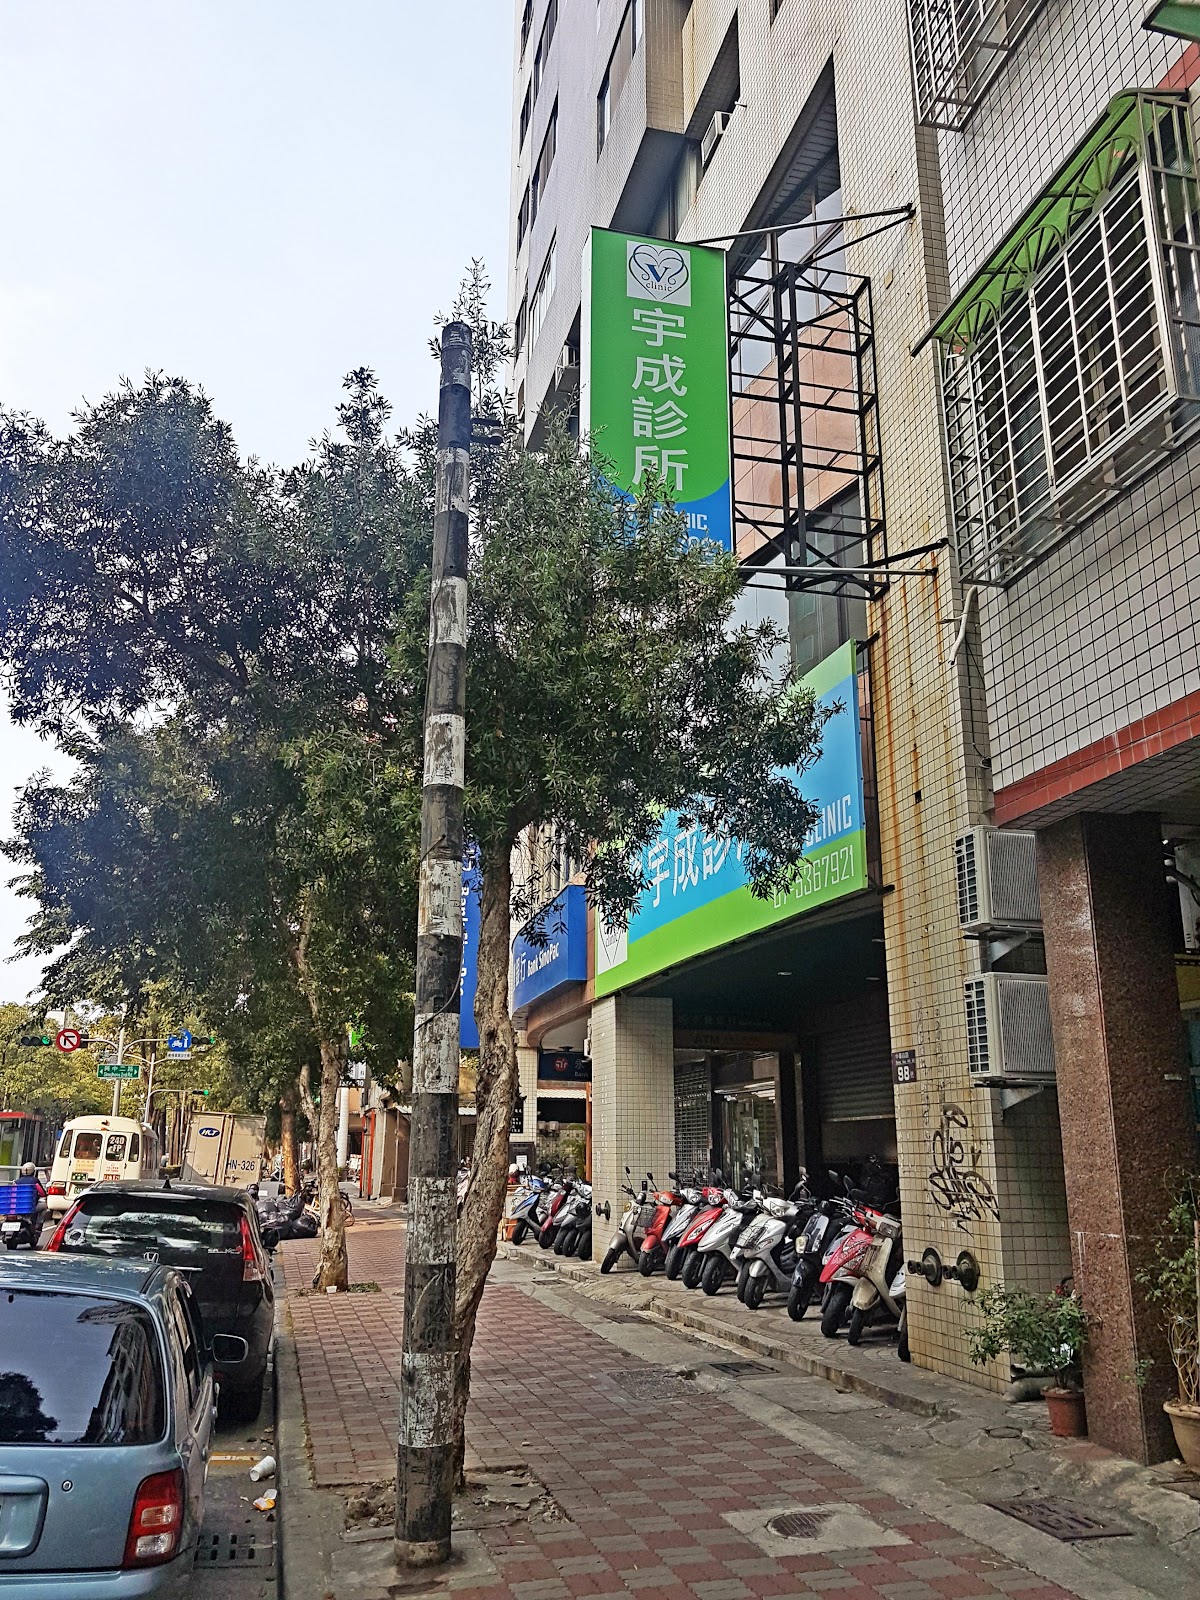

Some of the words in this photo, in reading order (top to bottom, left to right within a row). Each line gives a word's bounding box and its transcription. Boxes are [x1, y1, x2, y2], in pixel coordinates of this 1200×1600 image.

[645, 280, 673, 292] clinic
[631, 307, 689, 492] 宇成診所
[527, 954, 539, 978] Bank
[897, 1065, 910, 1082] 98
[109, 1136, 125, 1145] 240
